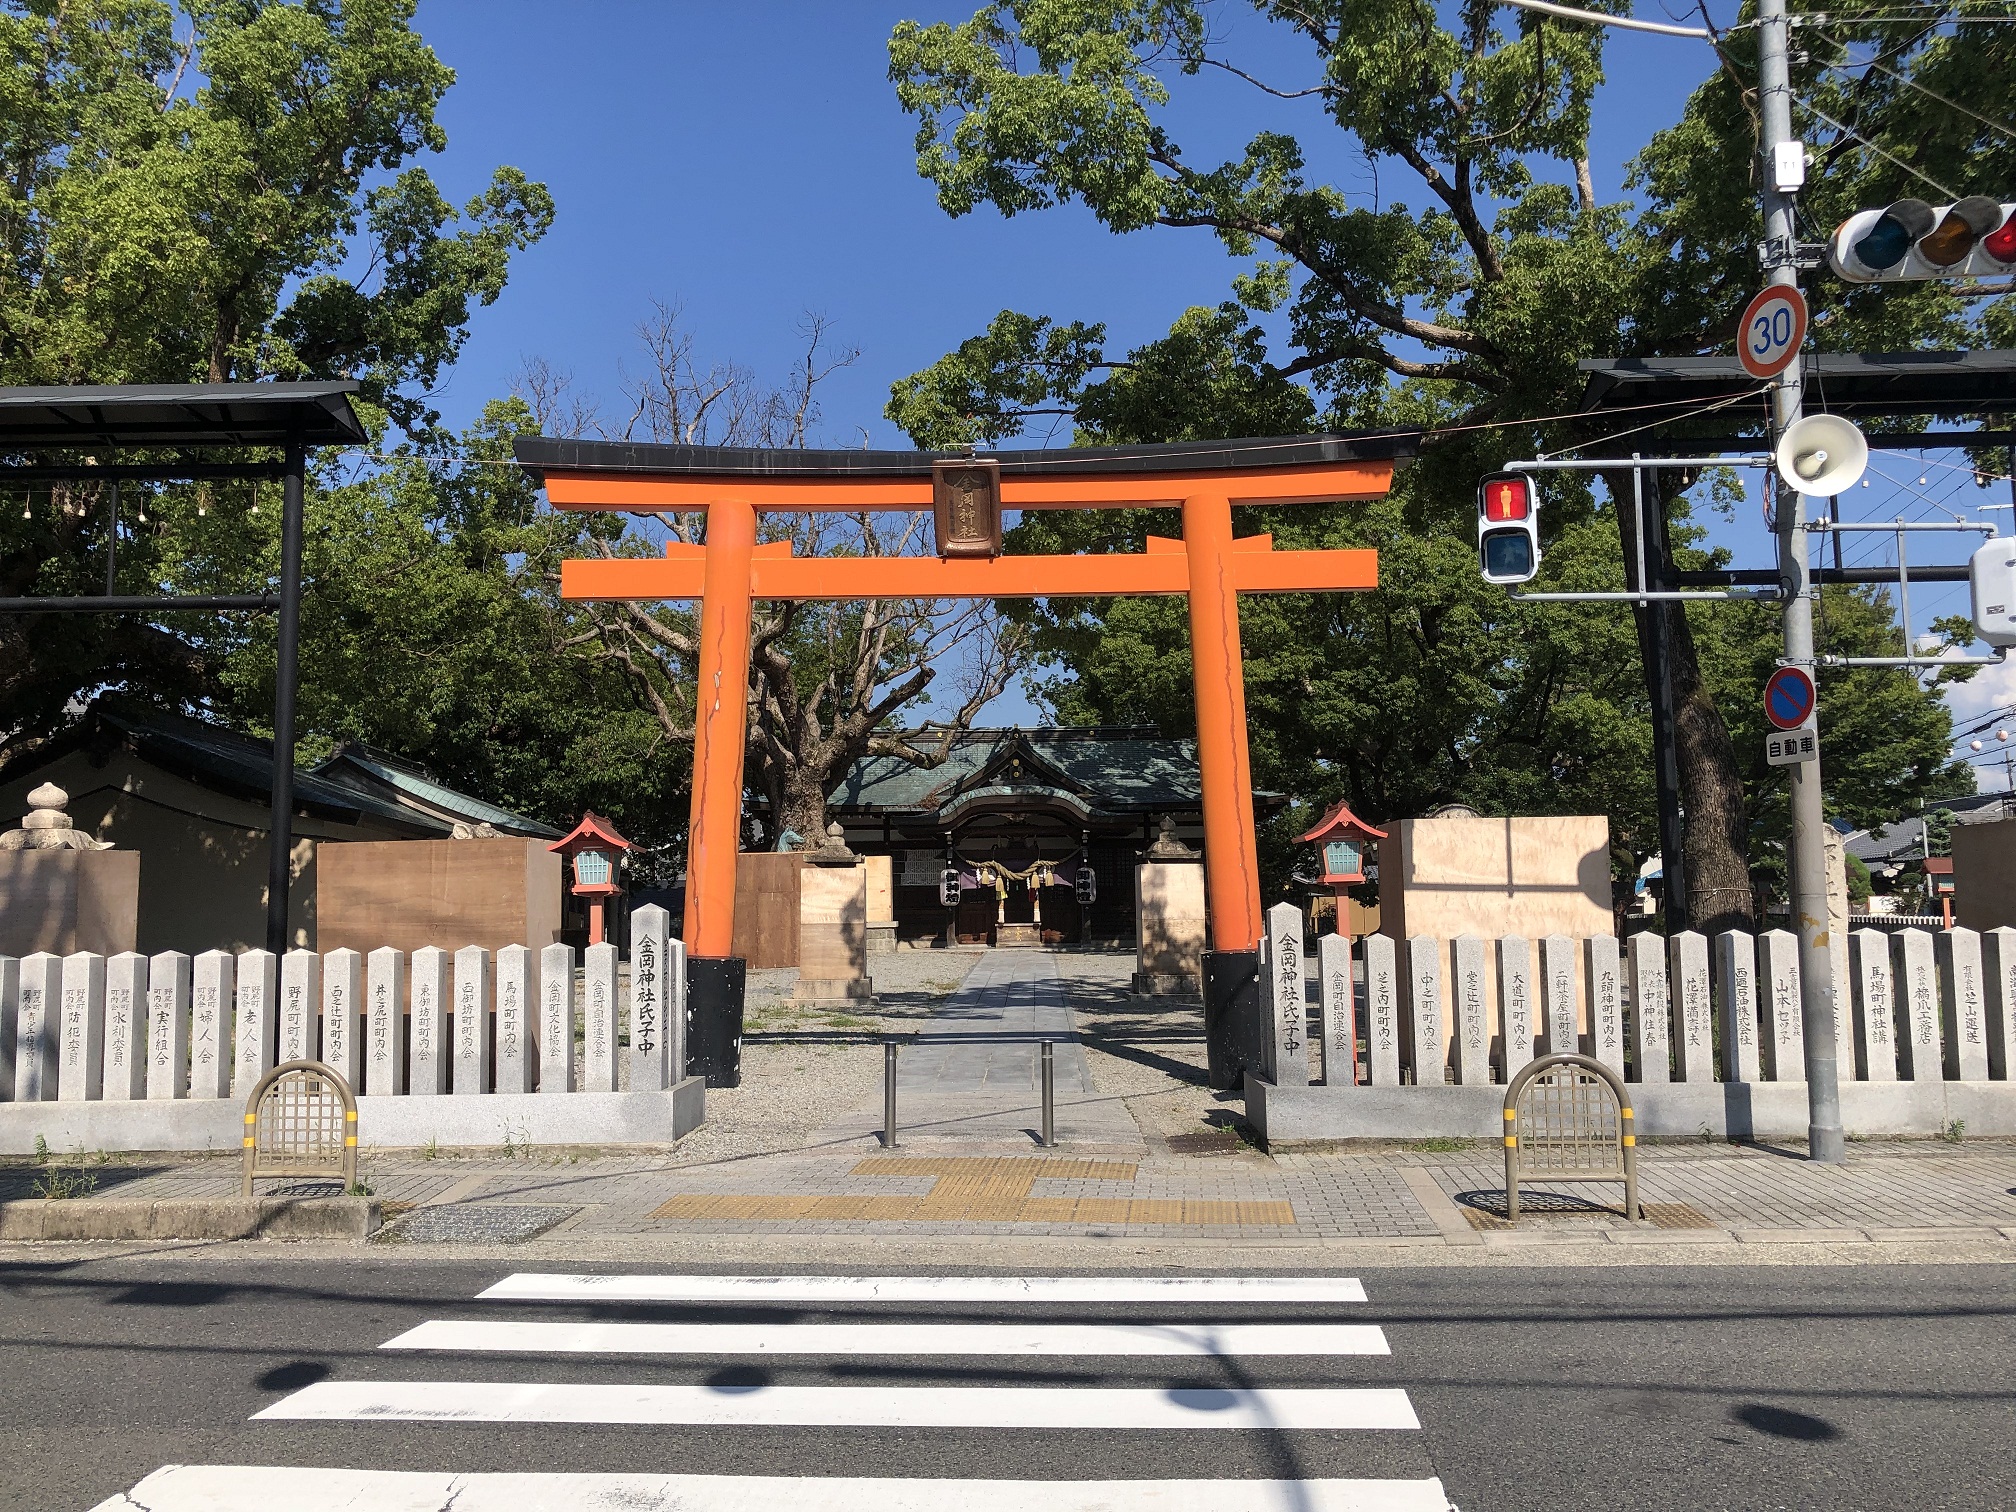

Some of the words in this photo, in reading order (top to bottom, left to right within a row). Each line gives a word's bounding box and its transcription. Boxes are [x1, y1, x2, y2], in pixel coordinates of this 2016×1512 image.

[1753, 307, 1790, 355] 30
[1769, 736, 1814, 758] 自動車
[285, 985, 302, 1062] 野尻町町内会
[330, 985, 343, 1062] 西之辻町町内会
[418, 983, 431, 1061] 東御坊町町内会
[461, 982, 475, 1059] 西御坊町町内会
[504, 981, 518, 1058] 馬場町町内会
[592, 979, 606, 1058] 金岡町自治連合会
[636, 933, 658, 1057] 金岡神社氏子中
[1278, 932, 1300, 1057] 金岡神社氏子中
[1331, 970, 1346, 1051] 金岡町自治連合会
[1377, 971, 1393, 1050] 芝之内町町内会
[1420, 971, 1437, 1050] 中之町町内会
[1512, 971, 1528, 1050] 大道町町内会
[1555, 971, 1572, 1048] 二軒茶屋町町内会
[1600, 970, 1616, 1048] 九頭神町町内会
[1870, 966, 1888, 1045] 馬場町神社講
[66, 1012, 82, 1067] 防犯委員
[112, 1012, 127, 1067] 水利委員
[154, 1010, 170, 1066] 実行組合
[197, 1010, 214, 1064] 婦人会
[242, 1009, 258, 1063] 老人会
